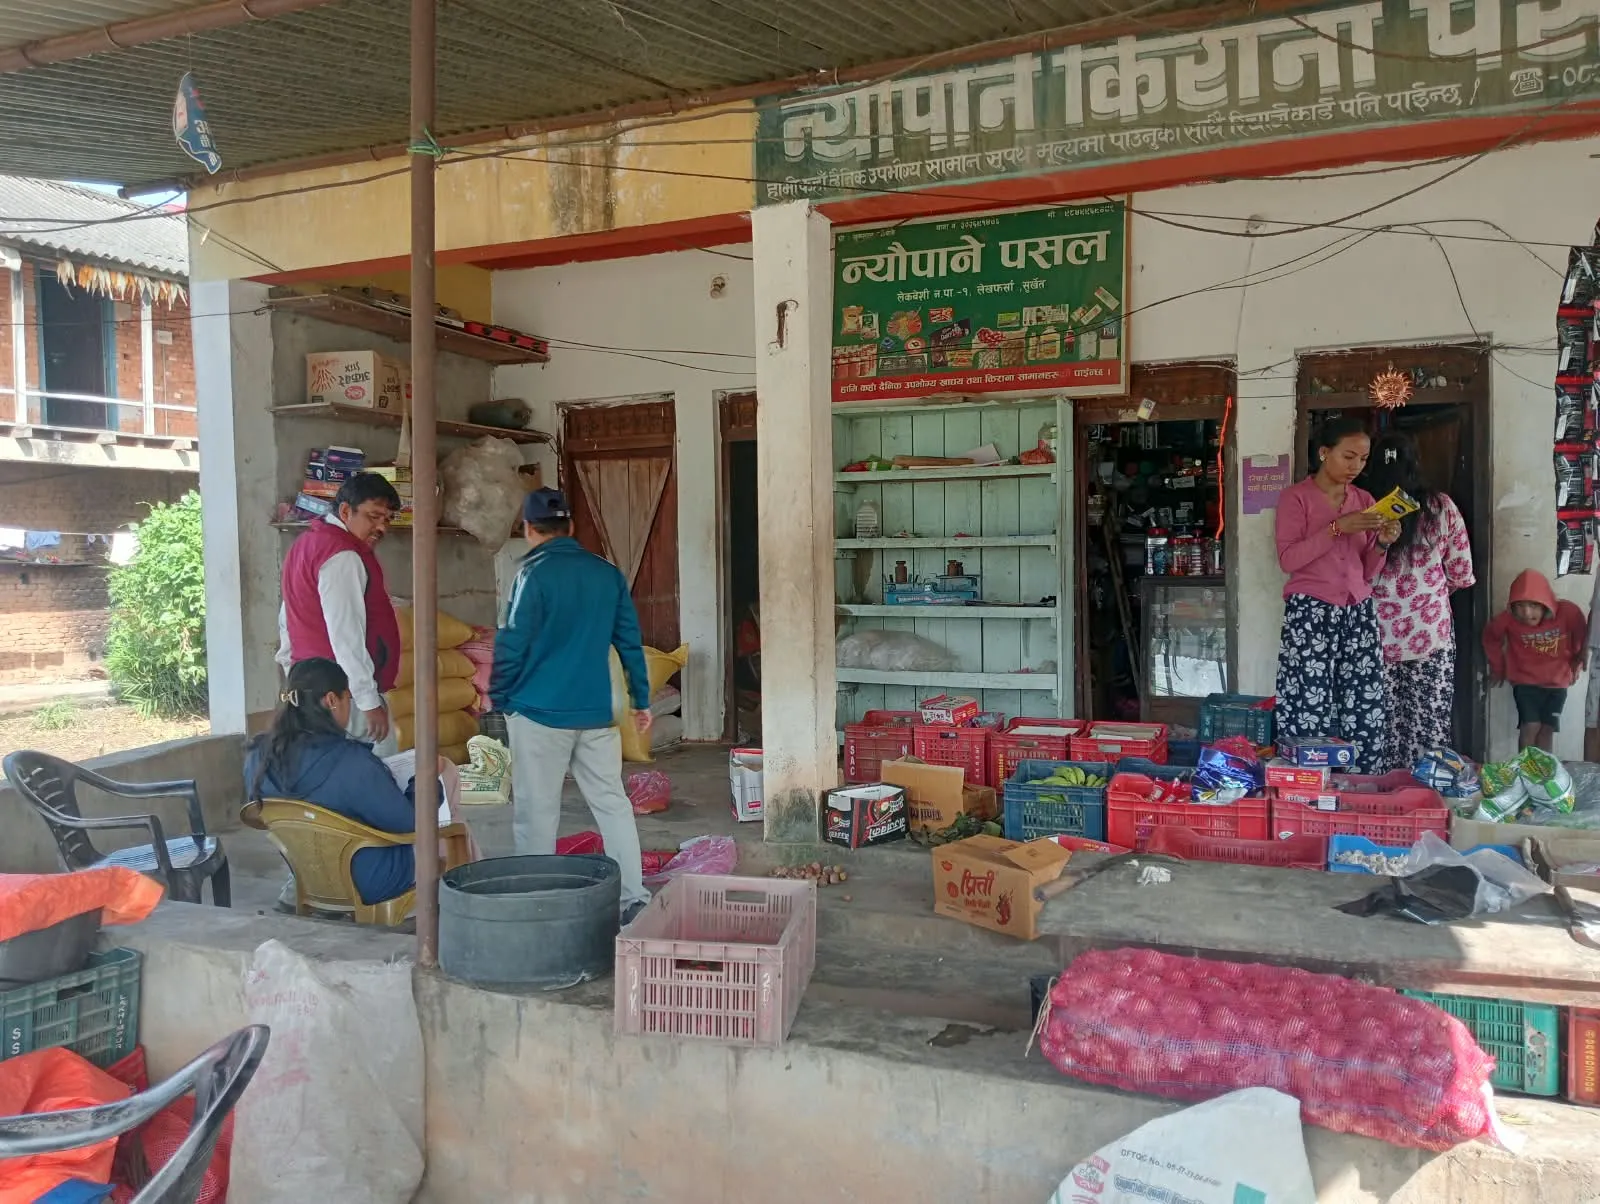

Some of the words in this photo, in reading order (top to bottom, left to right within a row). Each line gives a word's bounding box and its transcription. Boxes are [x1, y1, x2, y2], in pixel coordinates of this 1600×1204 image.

[925, 152, 983, 181] सामान
[1036, 134, 1107, 166] मूल्यमा
[1338, 92, 1384, 118] पनि
[842, 235, 986, 284] न्यौपाने
[999, 230, 1111, 270] पसल
